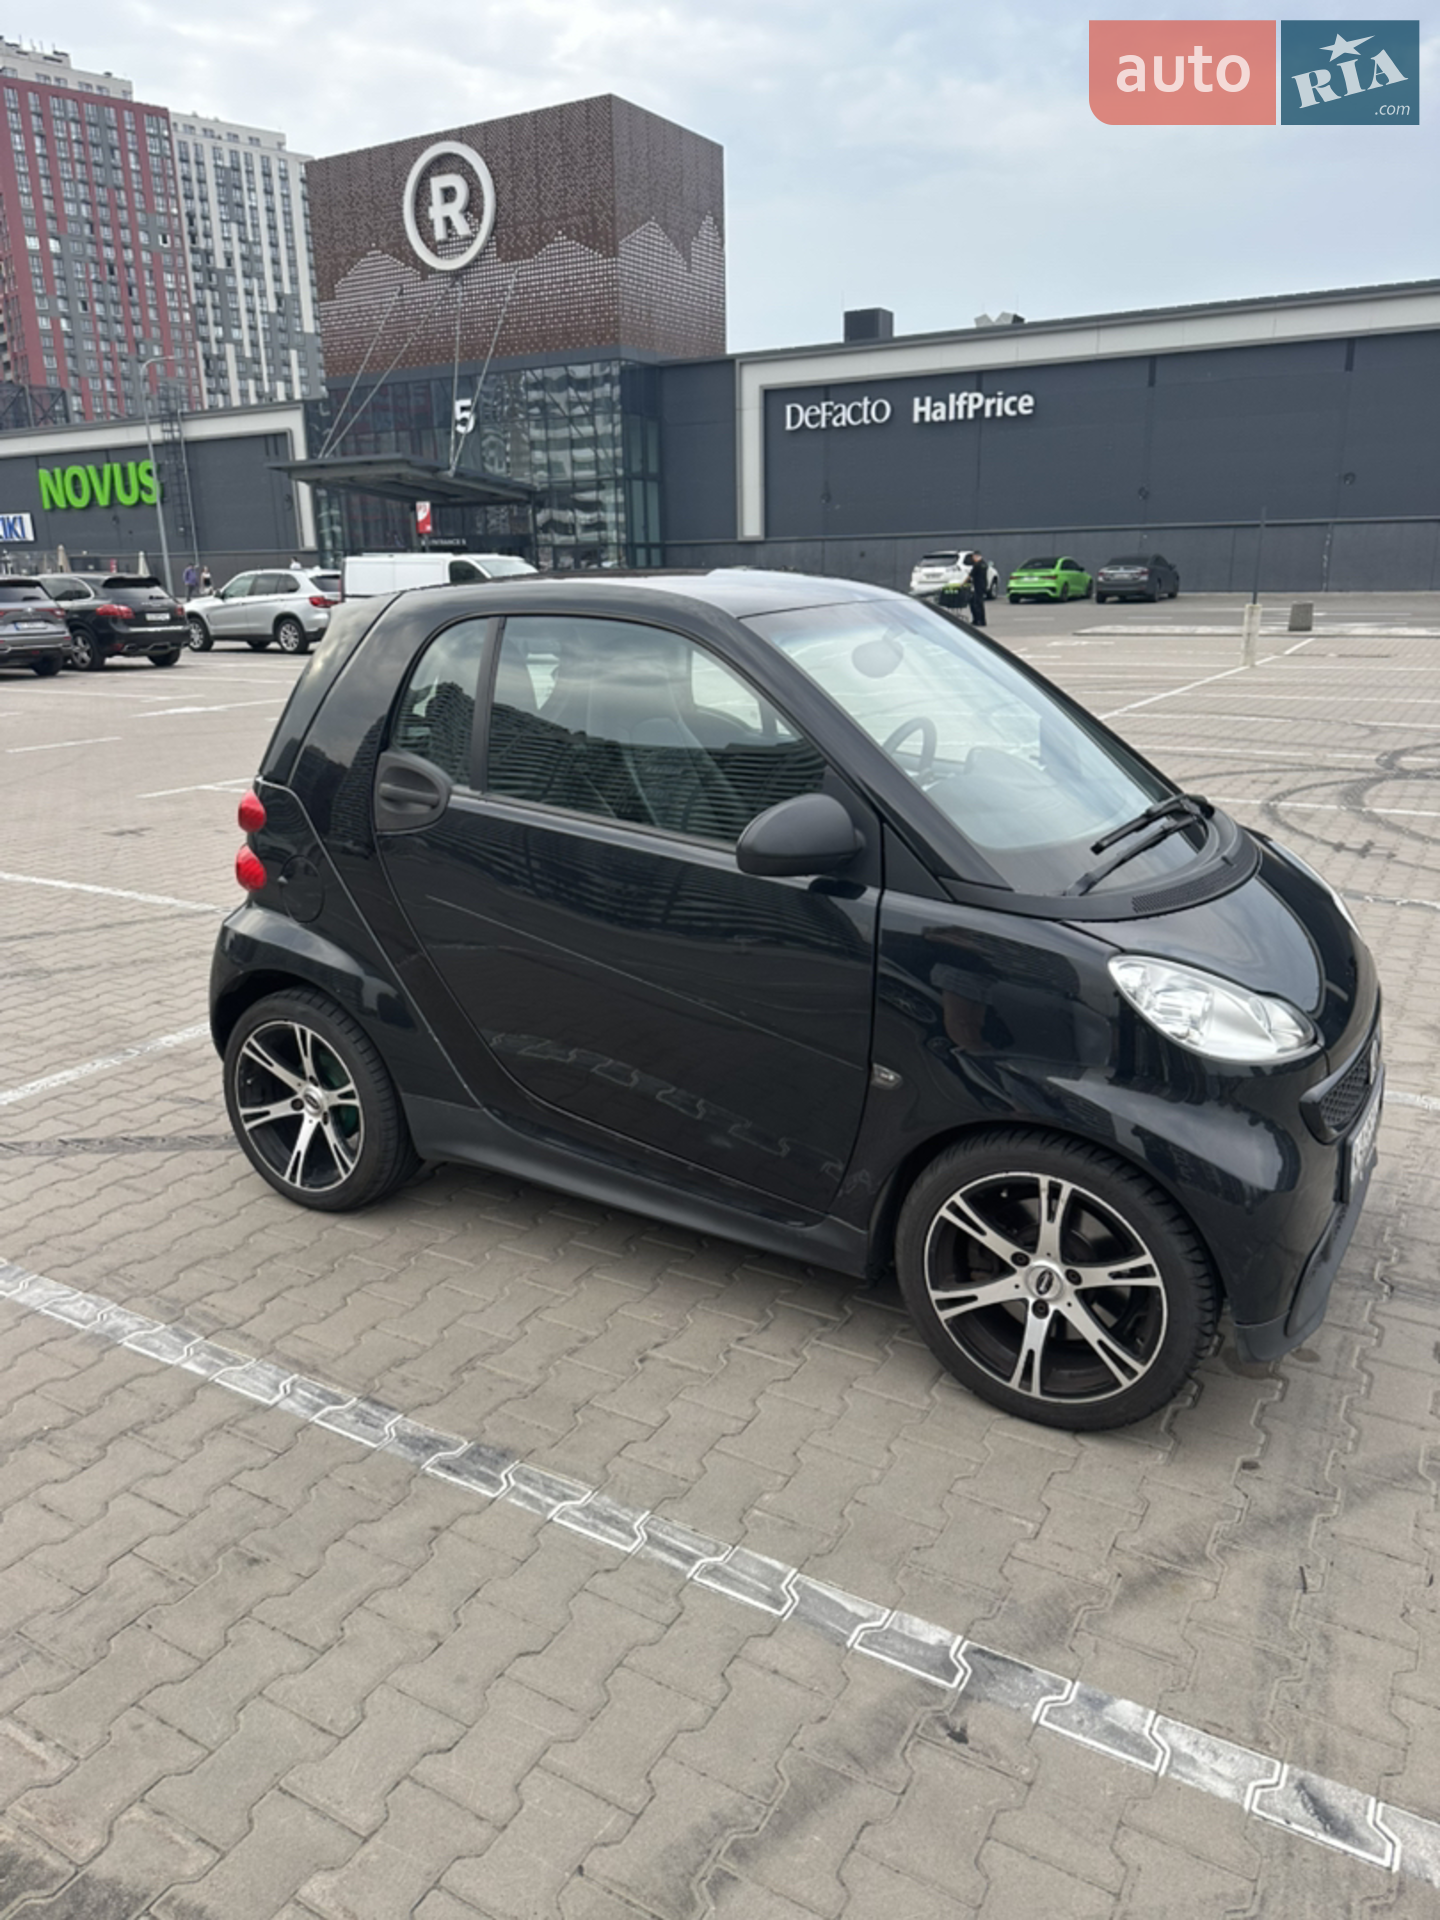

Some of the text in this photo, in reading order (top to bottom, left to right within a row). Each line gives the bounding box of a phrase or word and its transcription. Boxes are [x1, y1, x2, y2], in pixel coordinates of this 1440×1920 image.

[454, 398, 476, 434] 5
[785, 396, 892, 431] DeFacto
[912, 391, 1035, 424] HalfPrice
[38, 459, 162, 510] NOVUS
